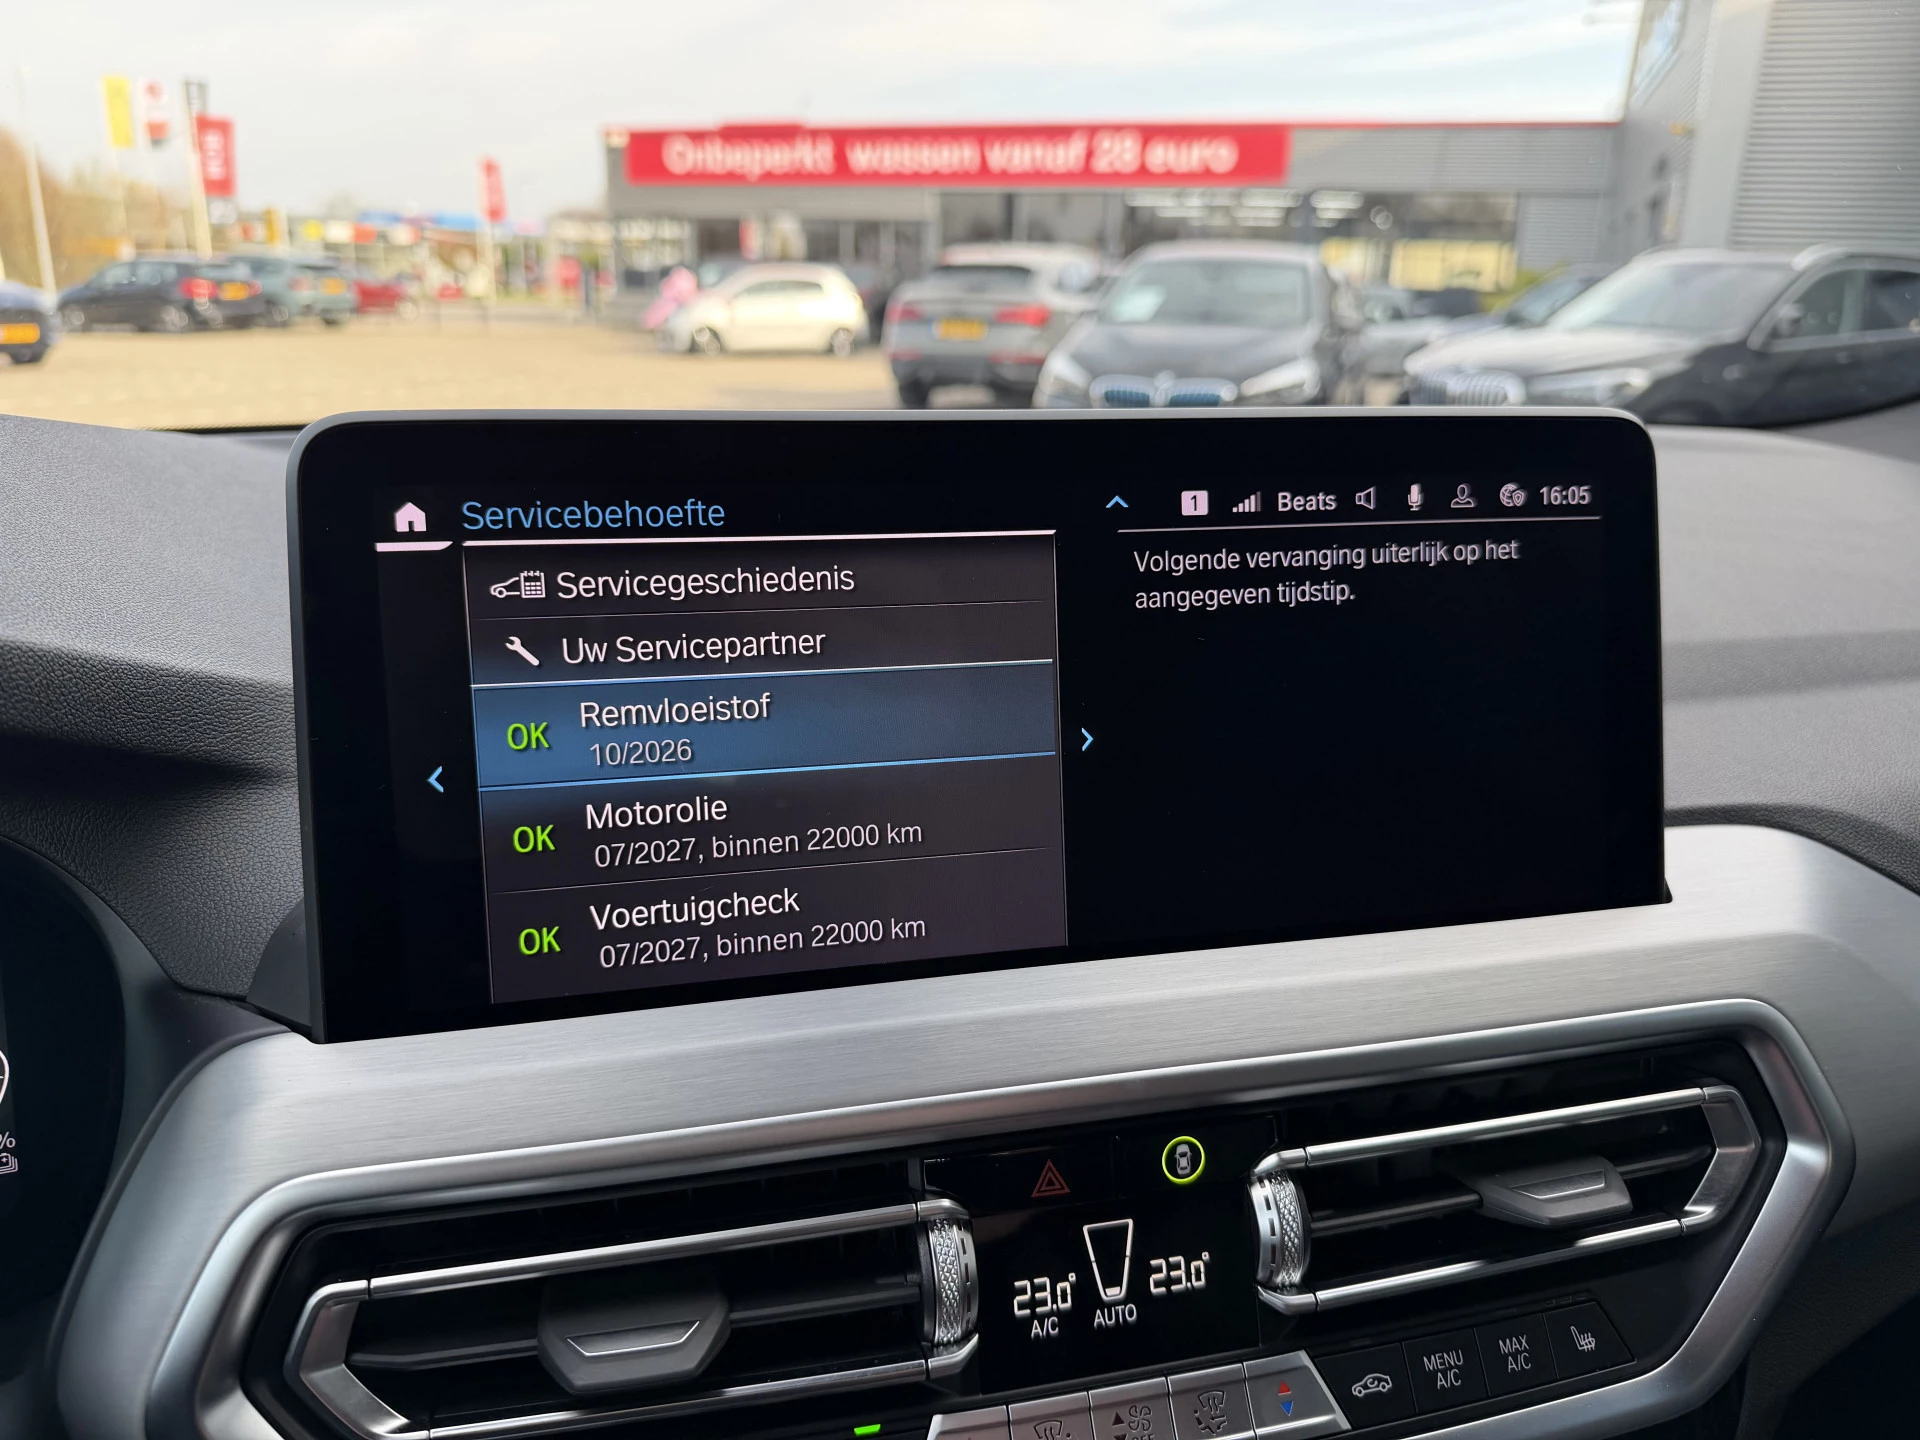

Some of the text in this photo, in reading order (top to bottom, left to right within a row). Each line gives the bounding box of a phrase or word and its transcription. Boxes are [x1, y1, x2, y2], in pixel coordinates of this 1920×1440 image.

[1144, 135, 1240, 174] euro
[1277, 491, 1337, 512] Beats
[1539, 485, 1592, 506] 16:05
[461, 498, 726, 531] Servicebehoefte
[1133, 539, 1520, 574] Volgende vervanging uiterlijk op het
[556, 564, 856, 601] Servicegeschiedenis
[1134, 580, 1356, 613] aangegeven tijdstip.
[561, 628, 827, 664] Uw Servicepartner
[579, 692, 772, 729] Remvloeistof
[506, 722, 550, 751] OK
[589, 738, 693, 767] 10/2026
[585, 796, 729, 831] Motorolie
[512, 824, 556, 853] OK
[593, 820, 923, 868] 07/2027, binnen 22000 km
[589, 888, 801, 931] Voertuigcheck
[518, 926, 561, 956] OK
[598, 916, 927, 969] 07/2027, binnen 22000 km
[1031, 1316, 1059, 1339] A/C
[1093, 1303, 1138, 1329] AUTO
[1498, 1334, 1530, 1355] MAX
[1423, 1349, 1464, 1372] MENU
[1507, 1352, 1532, 1373] A/C
[1437, 1368, 1462, 1390] A/C
